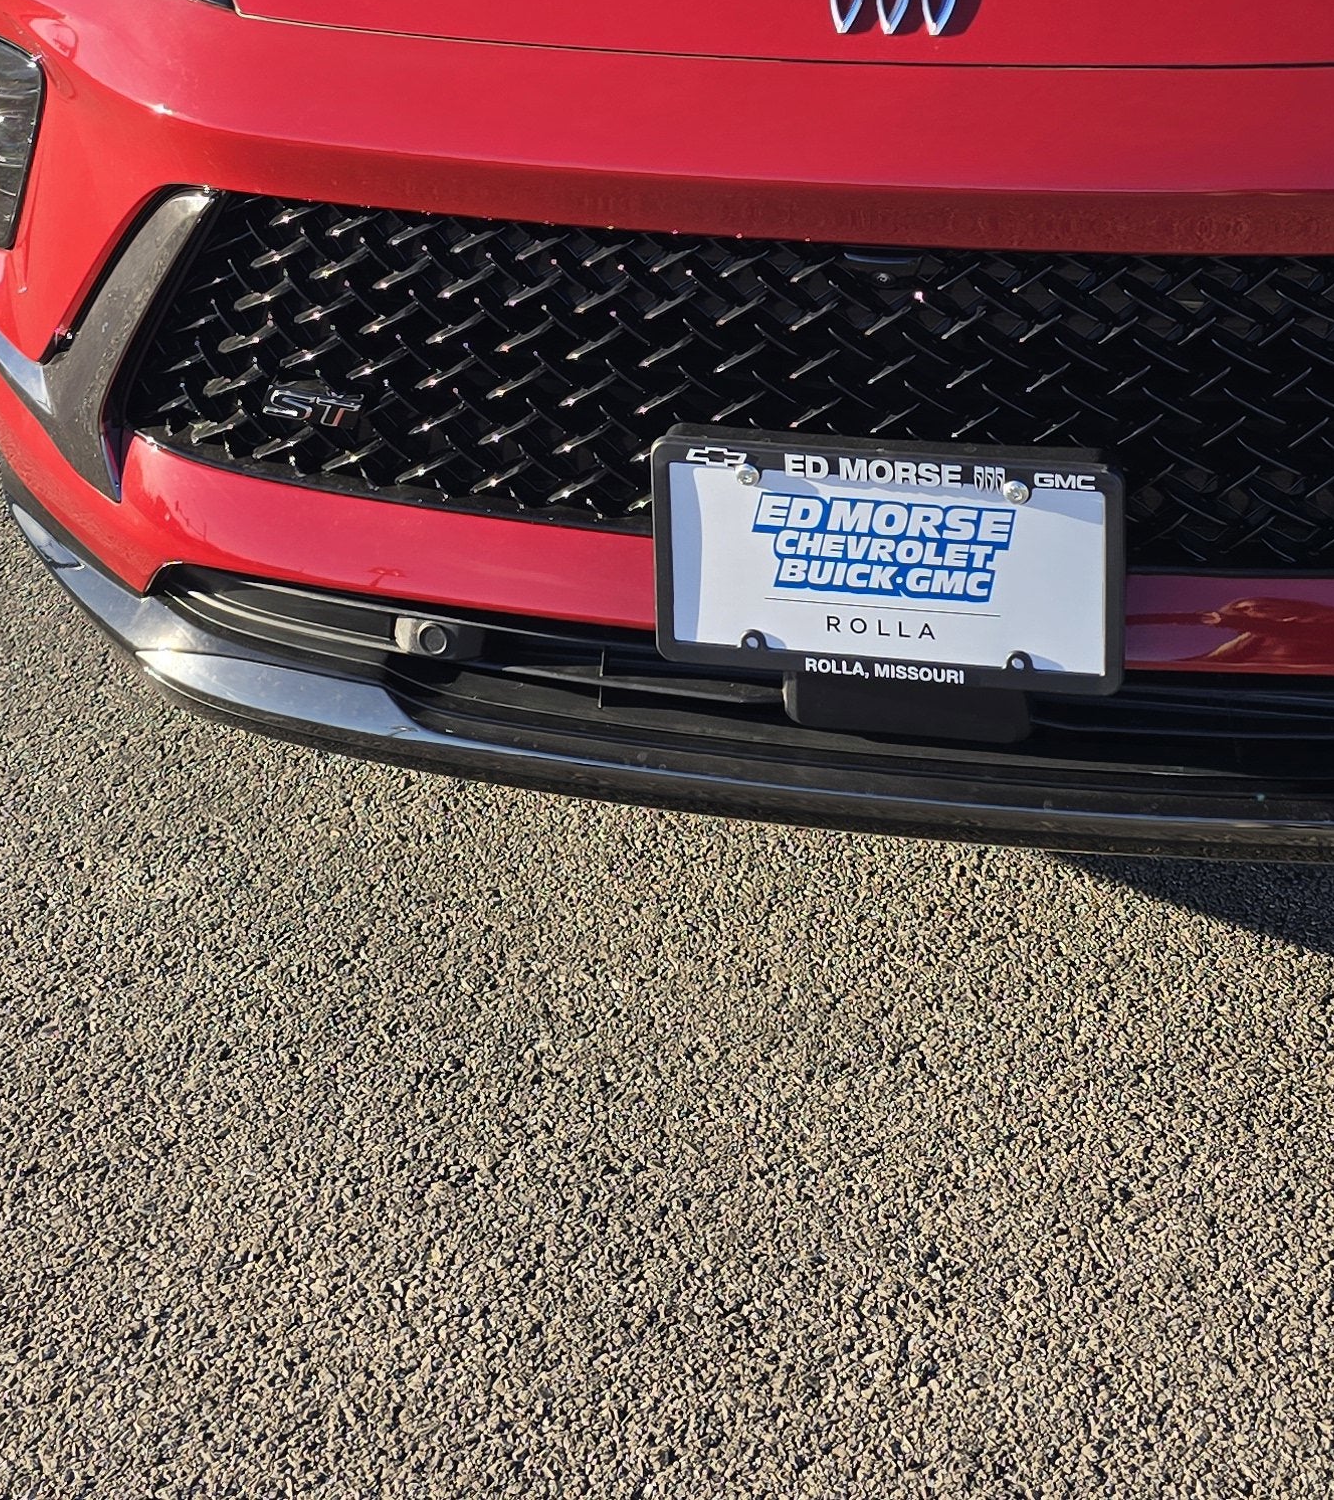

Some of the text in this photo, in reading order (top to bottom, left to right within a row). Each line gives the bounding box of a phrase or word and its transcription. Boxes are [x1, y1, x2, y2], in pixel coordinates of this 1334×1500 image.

[262, 388, 363, 427] ST
[783, 452, 1097, 492] ED MORSE GMC
[755, 493, 1013, 543] ED MORSE
[775, 529, 994, 569] CHEVROLET
[826, 615, 936, 640] ROLLA
[805, 657, 965, 685] ROLLA, MISSOURI
